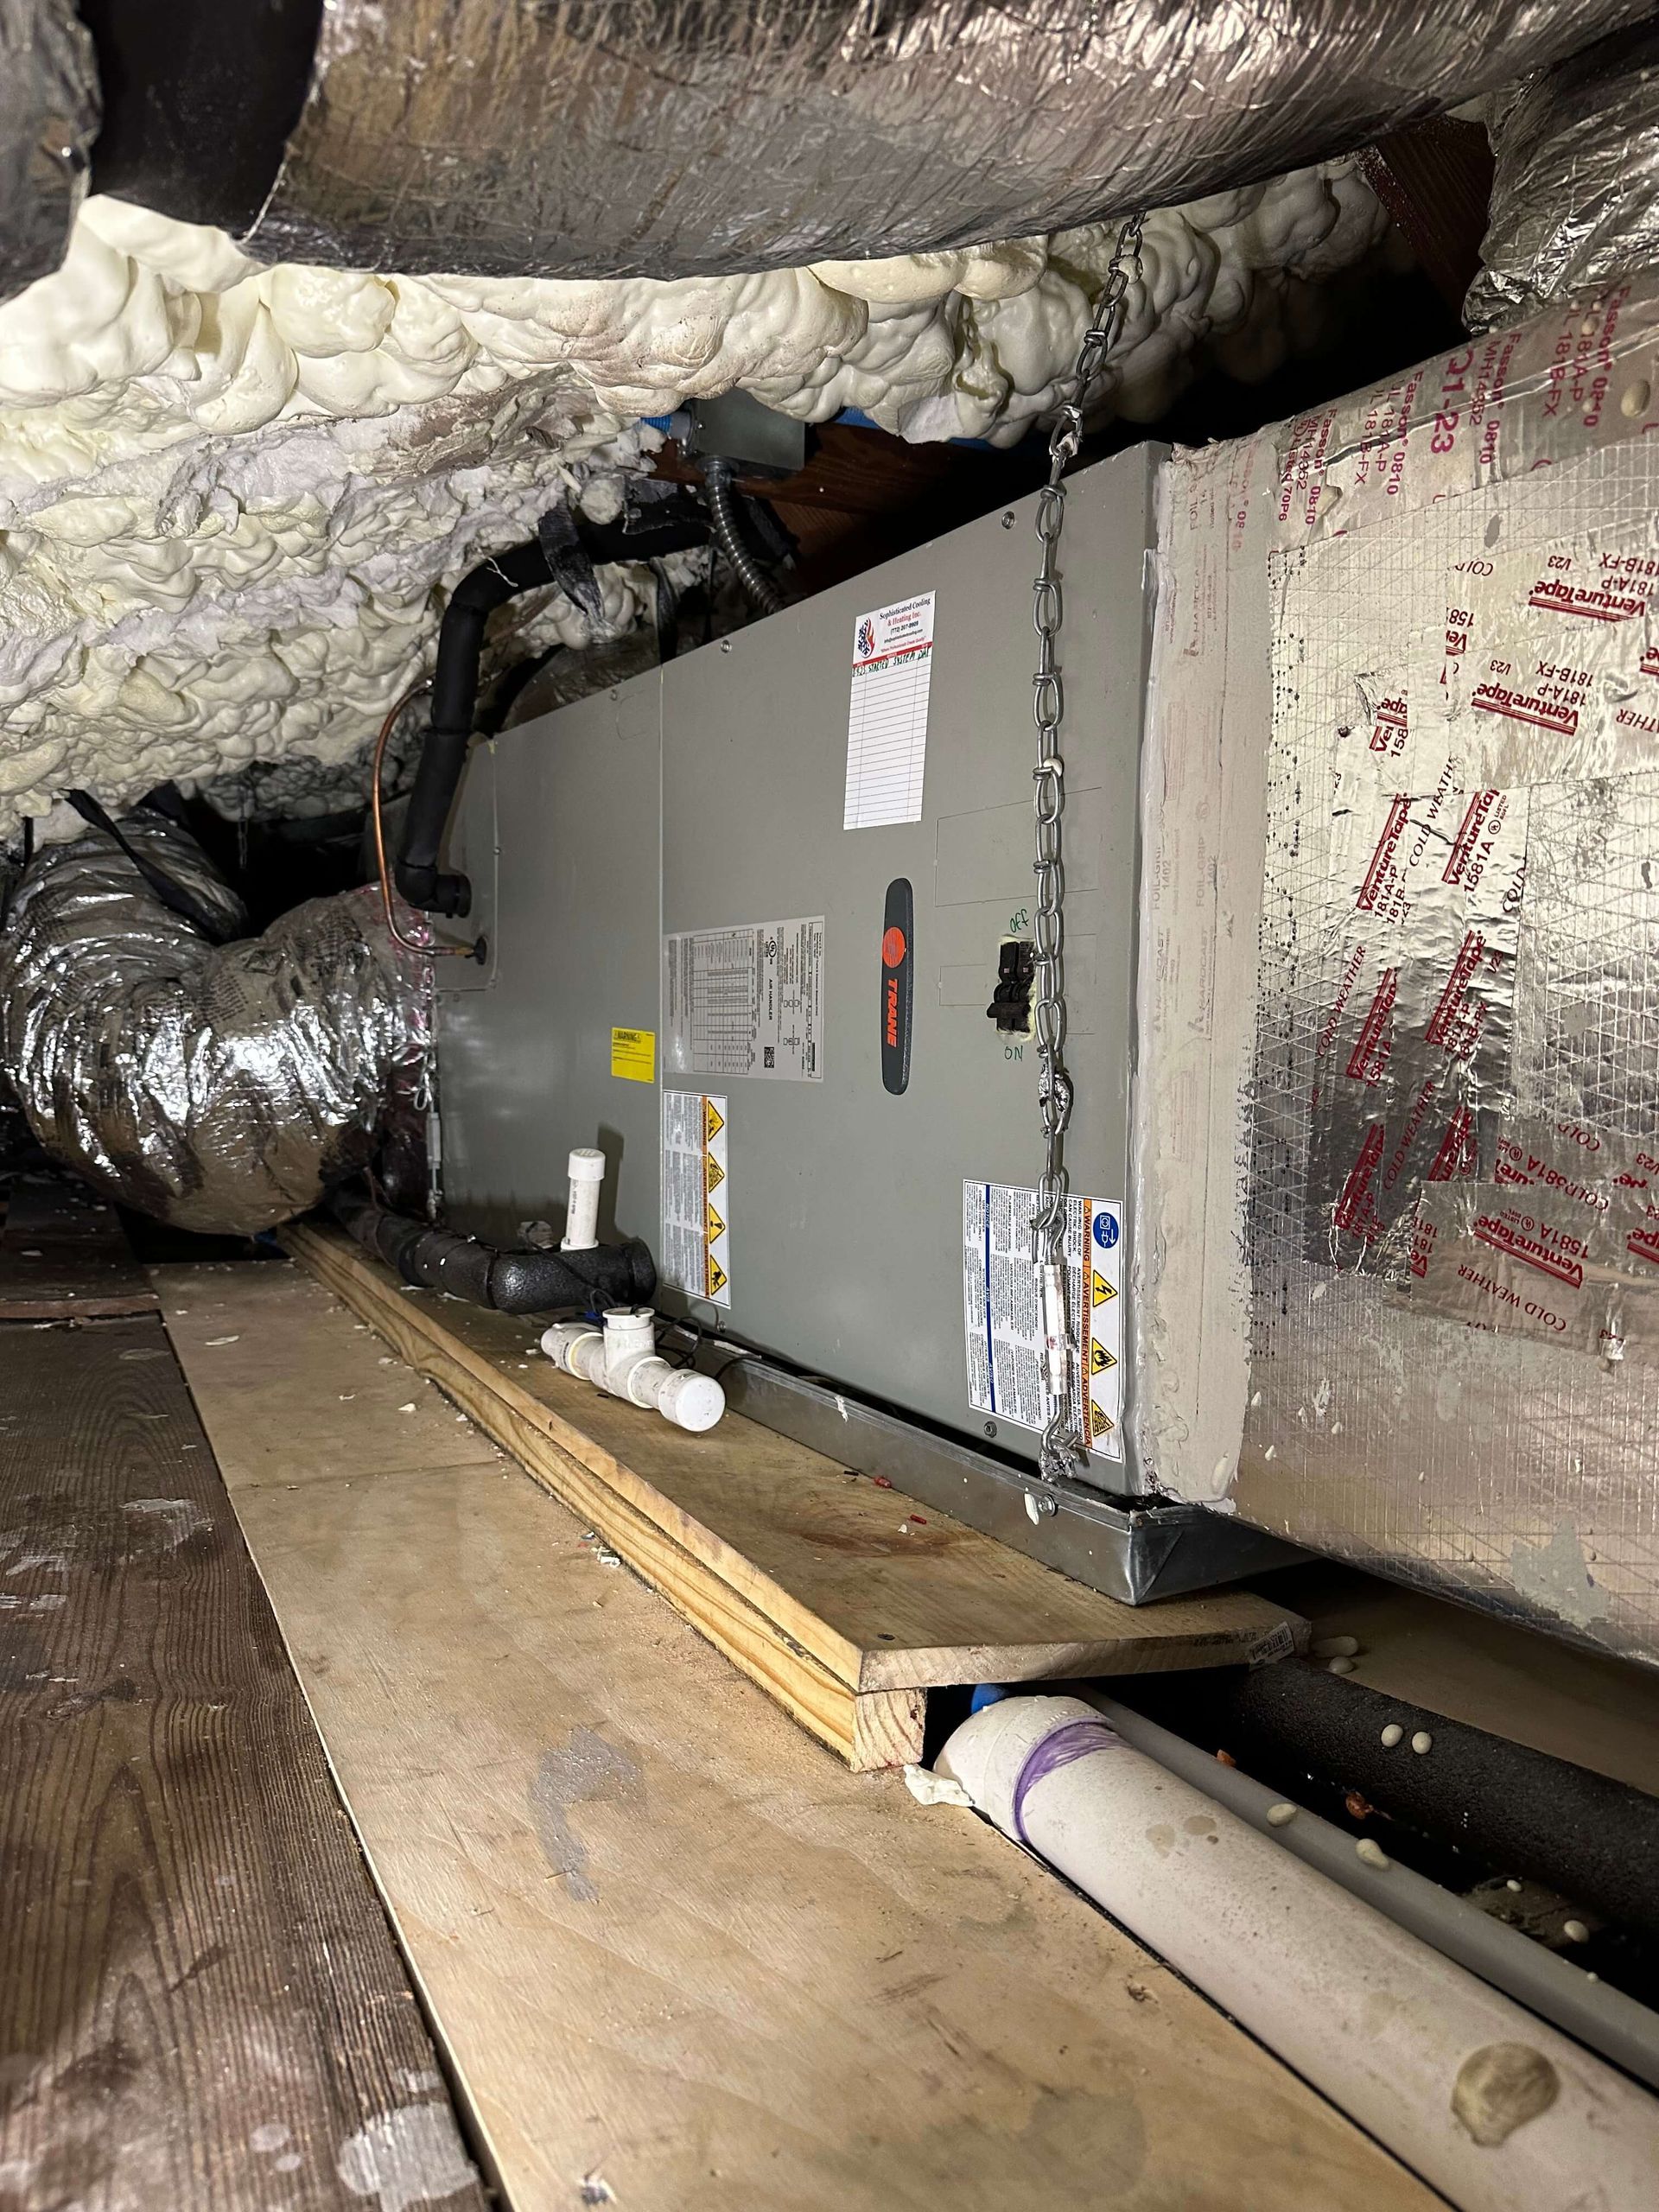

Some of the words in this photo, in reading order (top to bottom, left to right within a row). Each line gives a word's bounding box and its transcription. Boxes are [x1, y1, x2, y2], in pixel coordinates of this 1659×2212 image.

[1542, 331, 1573, 419] 181B-FX
[1354, 410, 1378, 486] 181B-FX
[1375, 408, 1396, 473] 181A-P
[1478, 420, 1501, 465] 0810
[1386, 451, 1406, 496] 0810
[1305, 486, 1321, 525] 0810
[912, 598, 931, 610] Cooling
[1601, 574, 1654, 597] 181A-P
[893, 614, 912, 626] Heating
[1535, 660, 1594, 689] 181B-FX
[1537, 682, 1587, 707] 181A-P
[1409, 823, 1432, 868] COLD
[1464, 842, 1496, 893] 1581A
[1374, 864, 1399, 918] 181A-P
[886, 978, 899, 1048] TRANE
[1316, 1016, 1339, 1058] COLD
[1332, 944, 1367, 1014] WEATHER
[1004, 1046, 1023, 1062] ON
[1383, 1149, 1406, 1191] COLD
[1401, 1082, 1436, 1148] WEATHER
[1539, 1222, 1590, 1260] 1581A
[1457, 1263, 1522, 1308] WEATHER
[1082, 1283, 1090, 1363] AVERTISSEMENT
[1523, 1301, 1567, 1332] COLD
[1082, 1379, 1091, 1447] ADVERTENCIA
